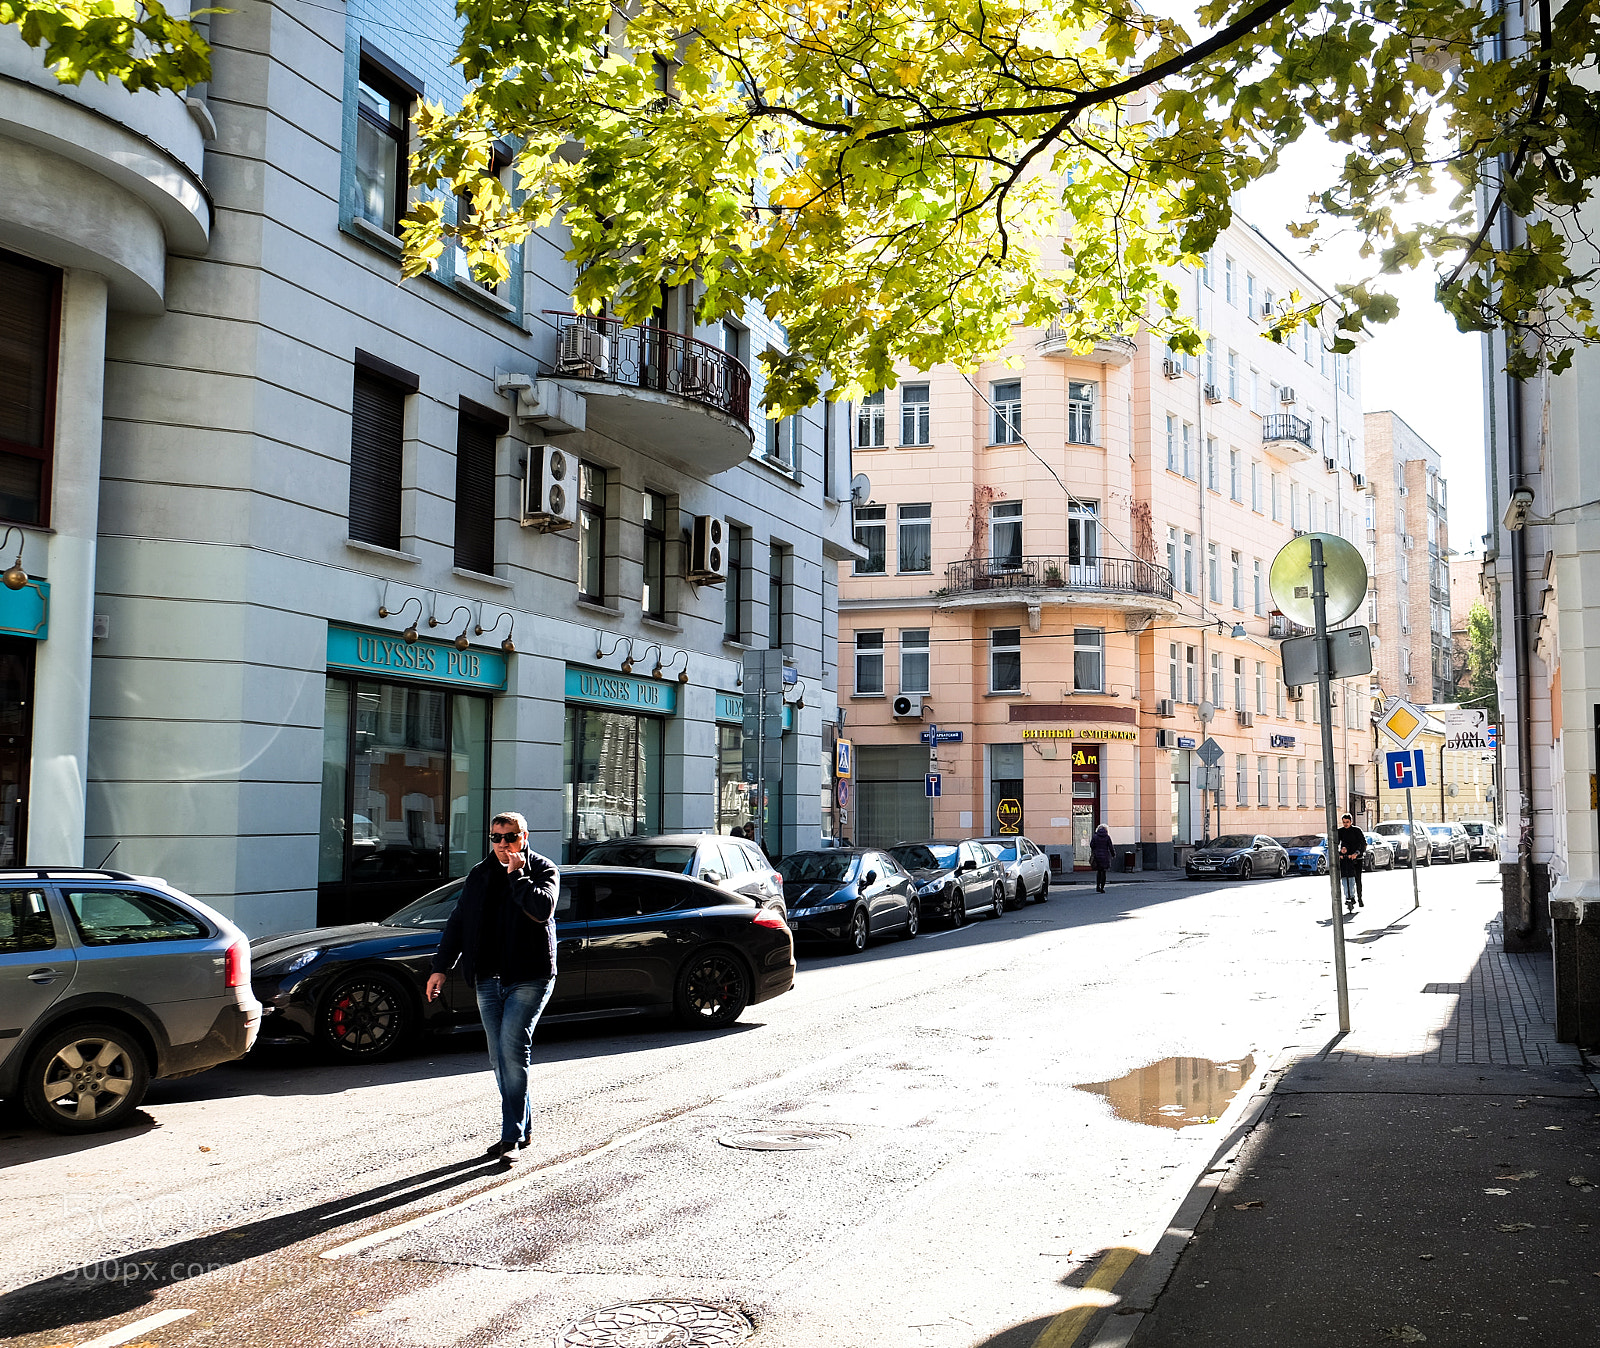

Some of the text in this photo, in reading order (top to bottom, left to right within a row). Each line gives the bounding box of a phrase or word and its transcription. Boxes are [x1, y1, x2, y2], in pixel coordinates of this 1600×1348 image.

[357, 637, 480, 678] ULYSSES PUB
[580, 674, 659, 705] ULYSSES PUB
[1022, 729, 1075, 739] ВИННЫЙ
